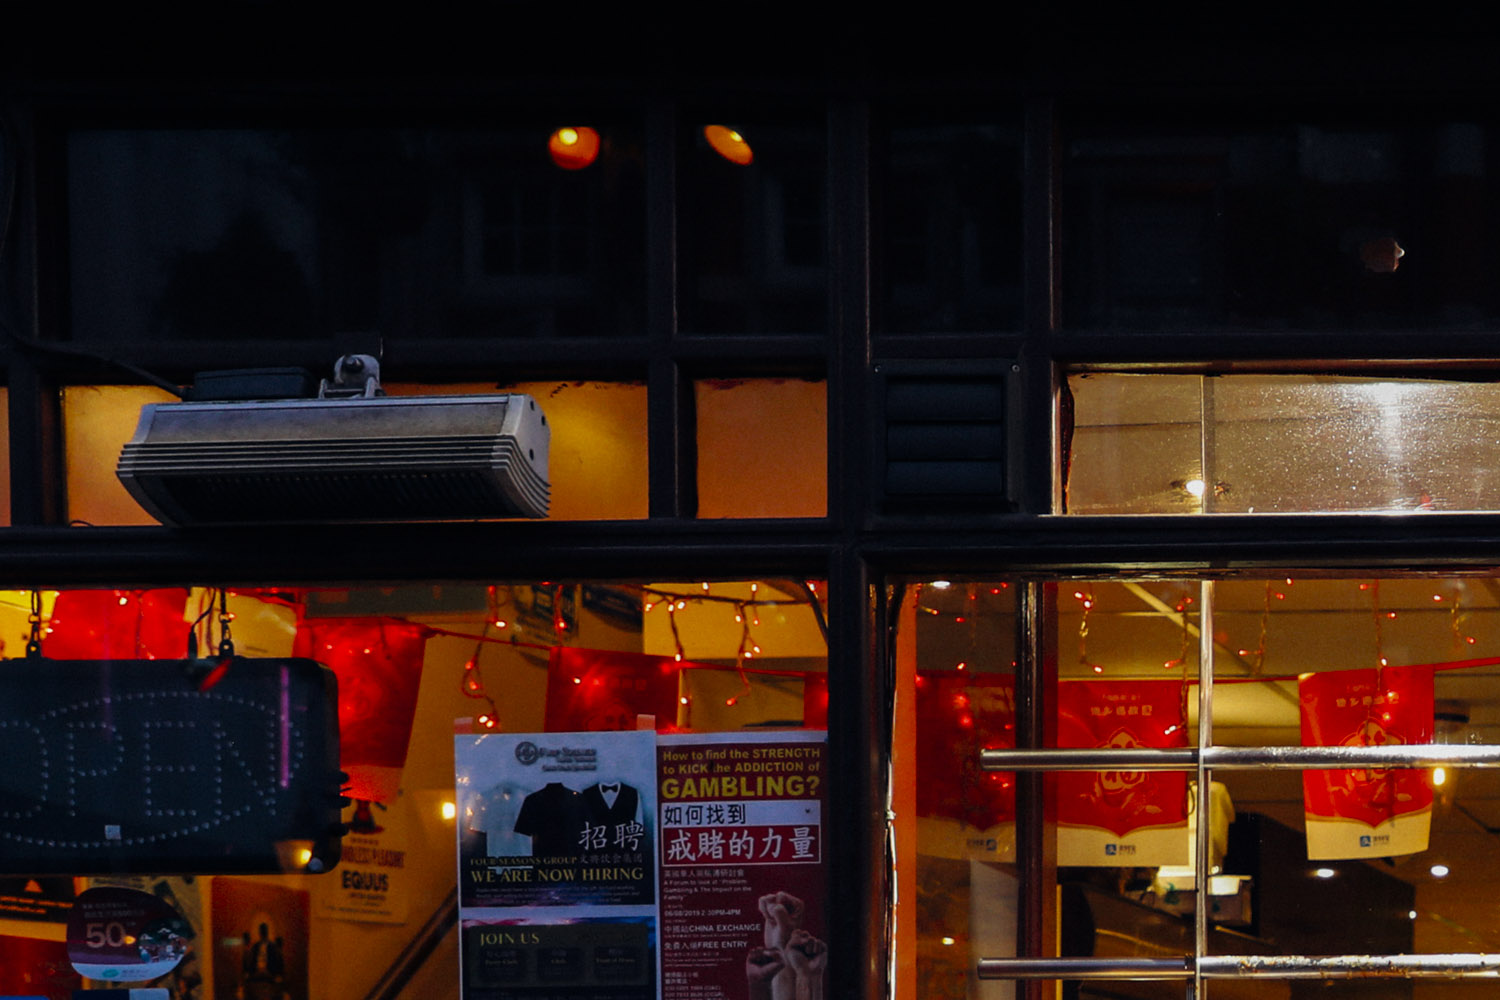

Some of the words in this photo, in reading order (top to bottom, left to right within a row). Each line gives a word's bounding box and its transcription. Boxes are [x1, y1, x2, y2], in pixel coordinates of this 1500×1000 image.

[663, 751, 689, 762] How
[693, 751, 704, 761] to
[706, 750, 726, 760] find
[729, 749, 749, 759] the
[753, 748, 820, 759] STRENGTH
[0, 720, 277, 817] OPEN
[663, 765, 675, 775] to
[678, 764, 708, 774] KICK
[734, 762, 804, 773] ADDICTION
[808, 762, 820, 772] of
[661, 775, 820, 799] GAMBLING?
[664, 803, 746, 826] 如何找到
[578, 820, 644, 851] 招聘
[667, 827, 816, 862] 戒賭的力量
[470, 857, 498, 866] FOUR
[543, 855, 578, 865] GROUP
[342, 870, 389, 892] EQUUS
[471, 870, 497, 883] WE
[500, 869, 533, 883] ARE
[537, 868, 576, 881] NOW
[582, 867, 644, 881] HIRING
[86, 922, 125, 949] 50
[716, 924, 761, 932] EXCHANGE
[480, 932, 514, 947] JOIN
[521, 933, 540, 944] US
[721, 940, 748, 949] ENTRY
